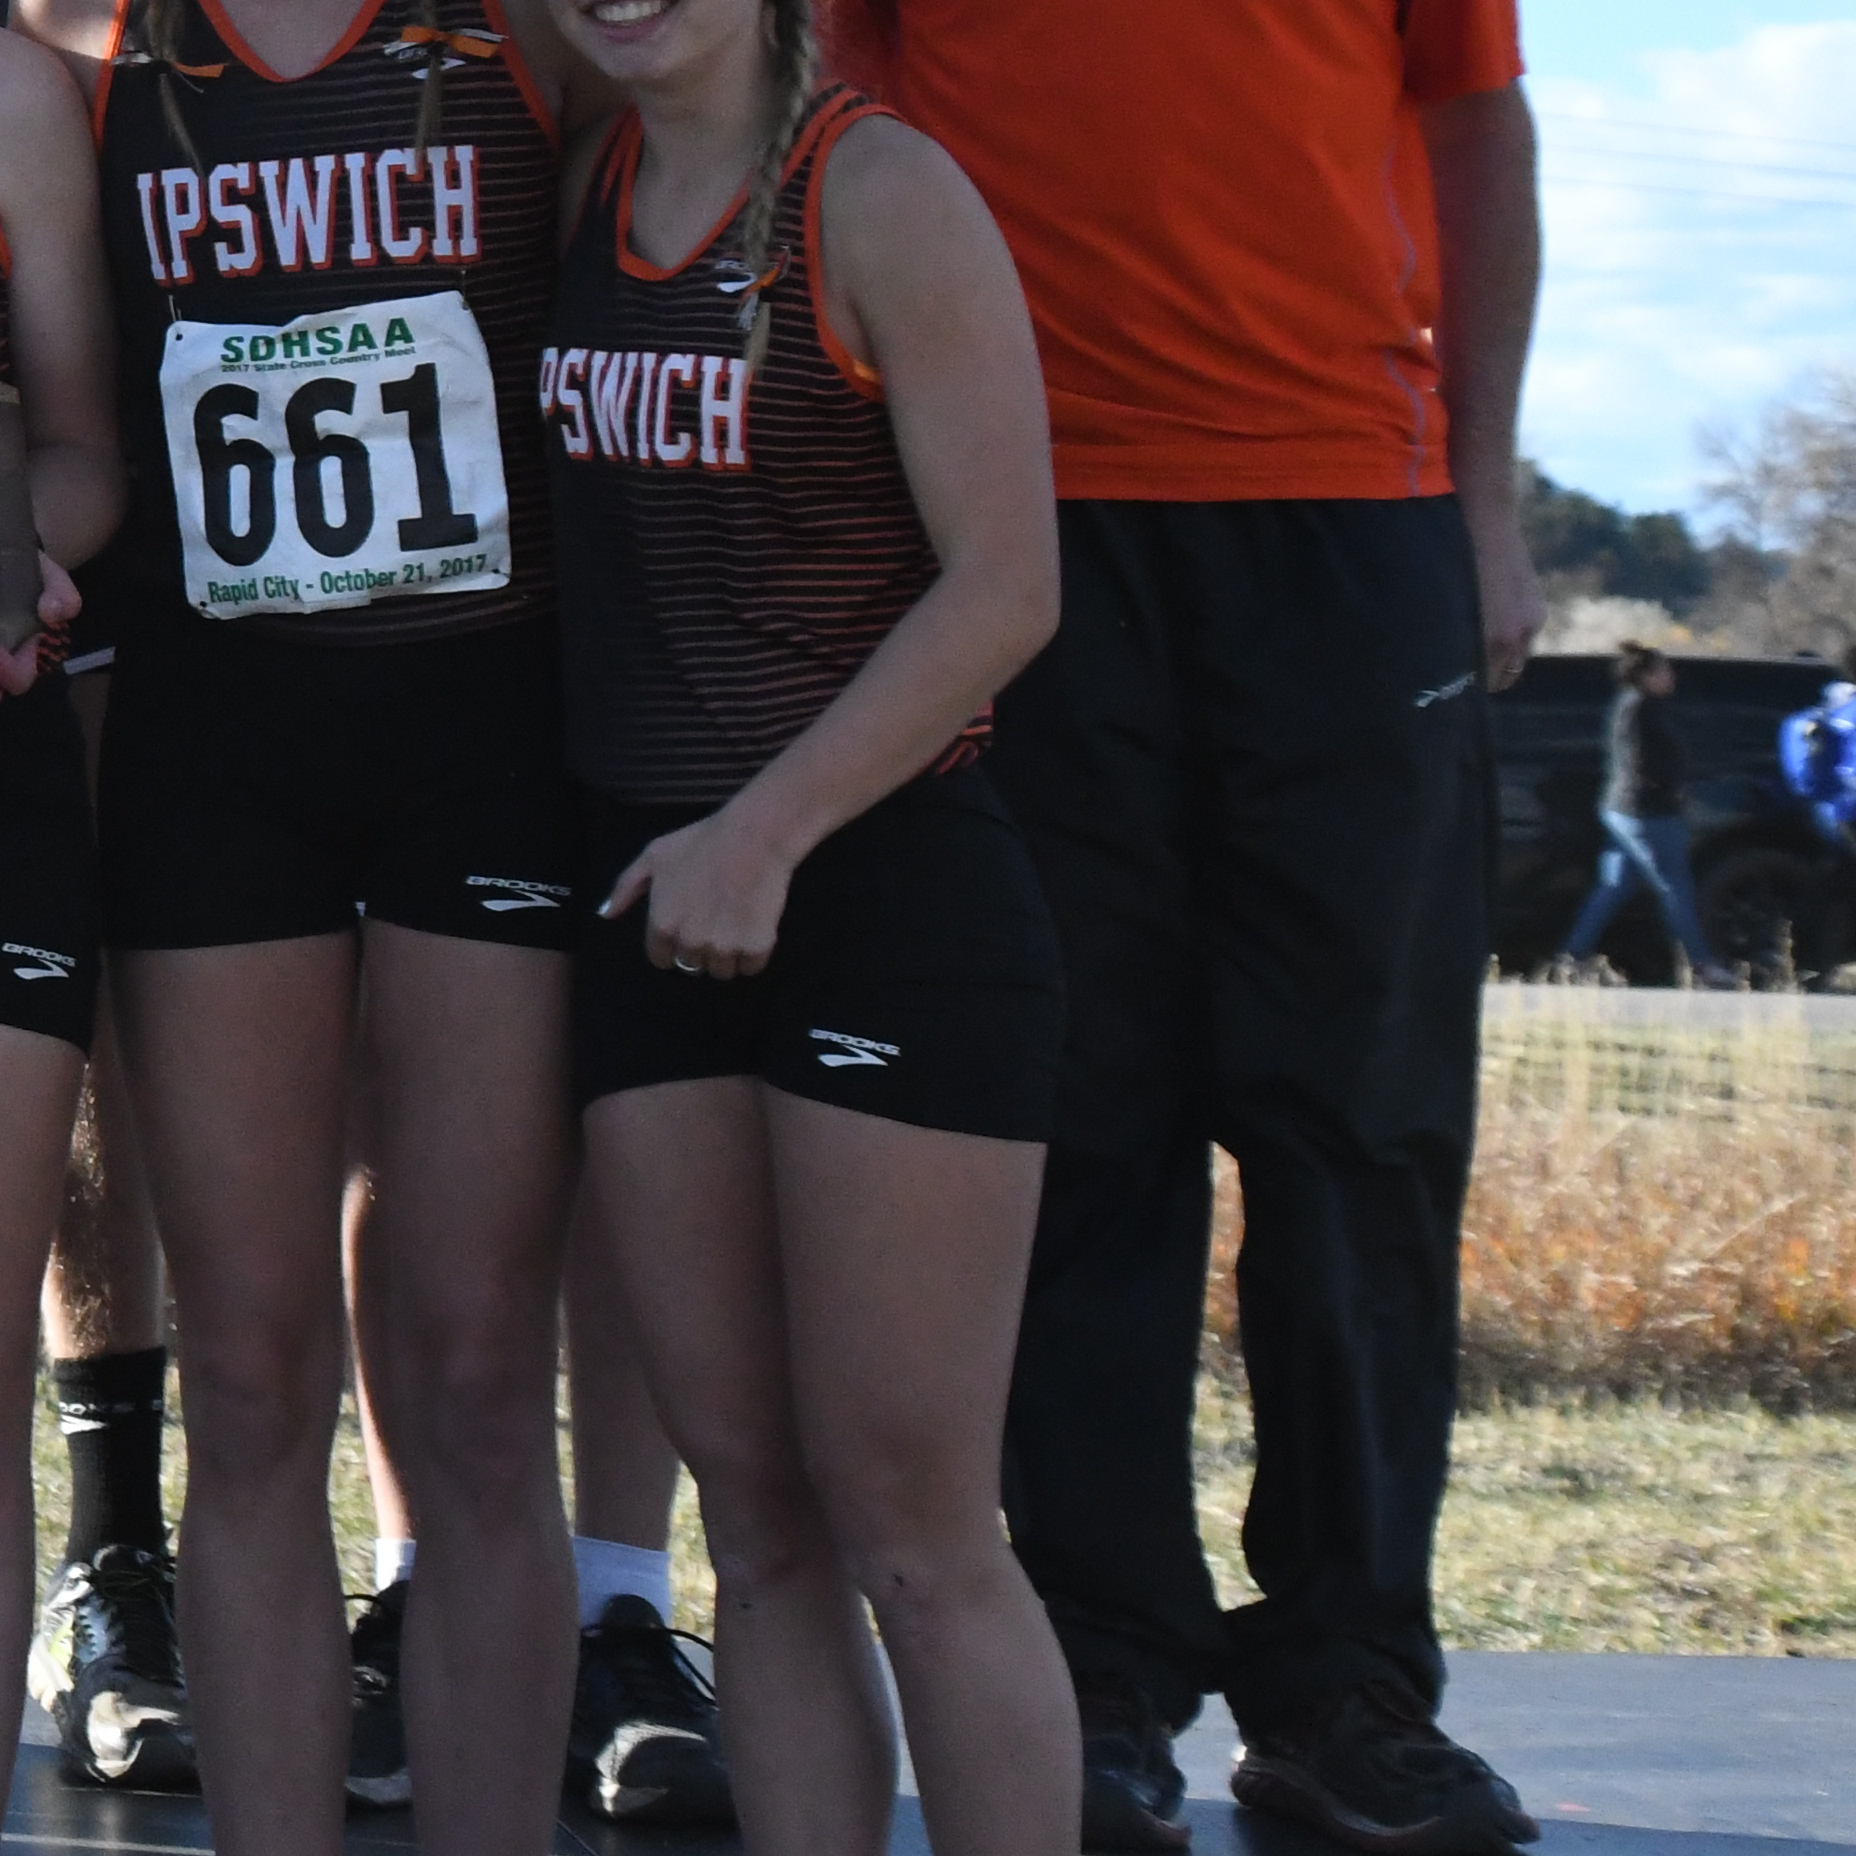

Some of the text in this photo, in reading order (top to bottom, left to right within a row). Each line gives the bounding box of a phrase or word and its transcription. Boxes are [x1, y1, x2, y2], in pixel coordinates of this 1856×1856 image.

[137, 145, 482, 288] IPSWICH
[220, 317, 416, 364] SDHSAA
[254, 362, 286, 372] State
[290, 359, 327, 370] Cross
[329, 352, 381, 366] Country
[385, 345, 416, 358] Meet
[539, 347, 752, 472] PSWICH
[194, 362, 478, 567] 661
[207, 577, 259, 605] Rapid
[263, 575, 300, 600] City
[320, 567, 397, 594] October
[403, 562, 432, 584] 21,
[440, 553, 488, 578] 2017
[466, 875, 571, 896] BROOKS
